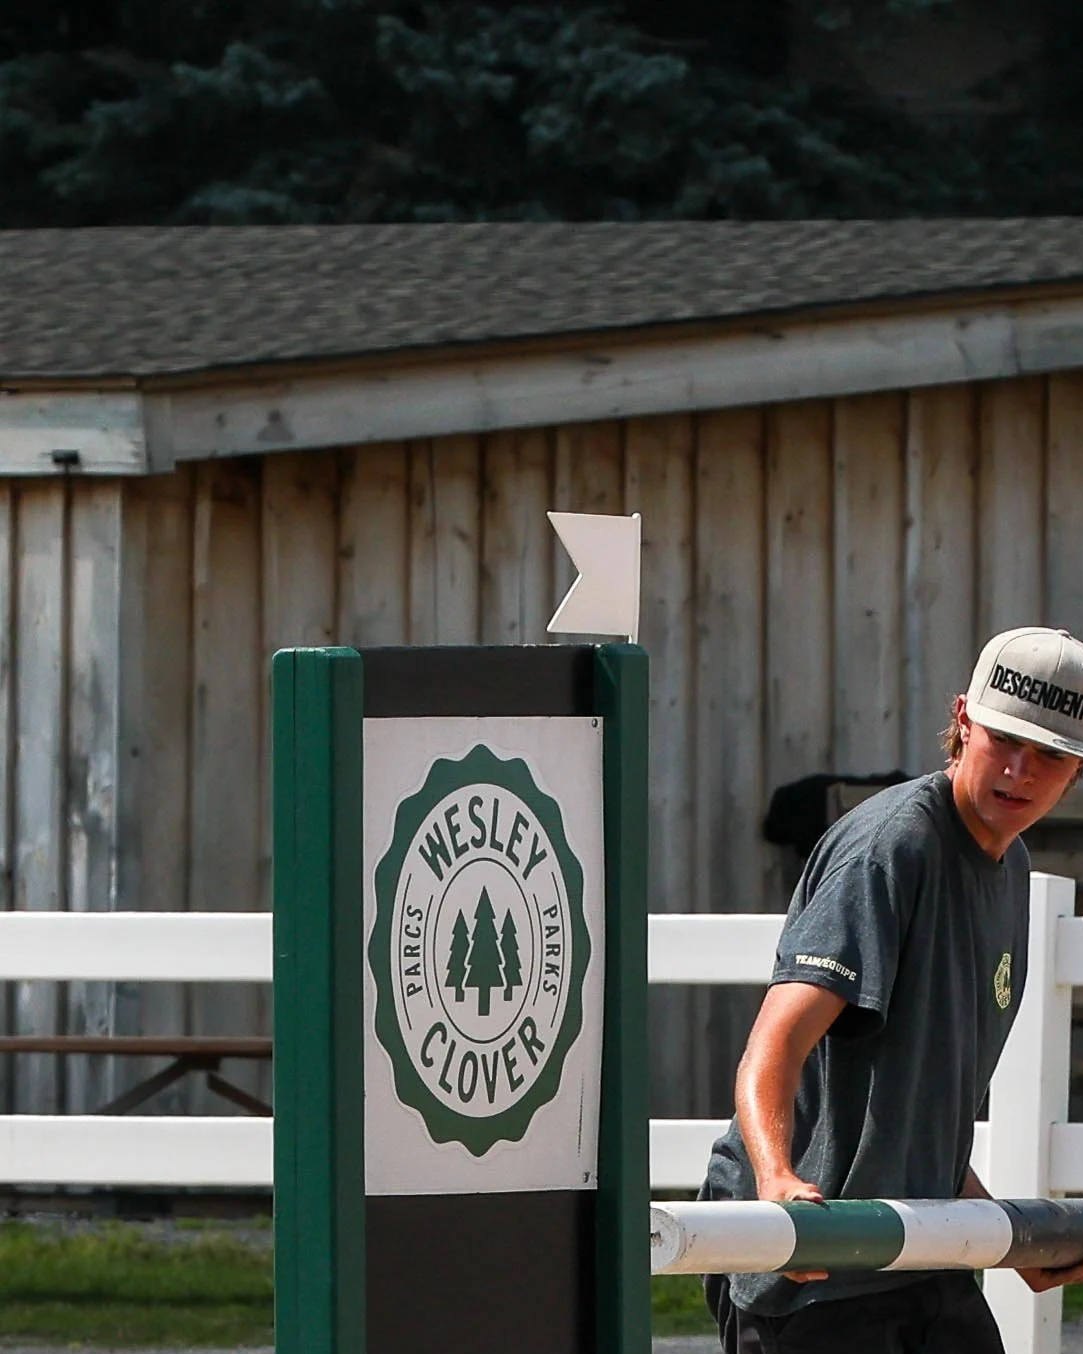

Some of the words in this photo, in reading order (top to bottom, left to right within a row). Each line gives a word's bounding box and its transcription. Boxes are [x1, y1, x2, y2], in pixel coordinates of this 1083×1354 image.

[418, 795, 548, 882] WESLEY
[405, 904, 424, 997] PARCS
[542, 904, 561, 997] PARKS
[420, 1015, 546, 1104] CLOVER
